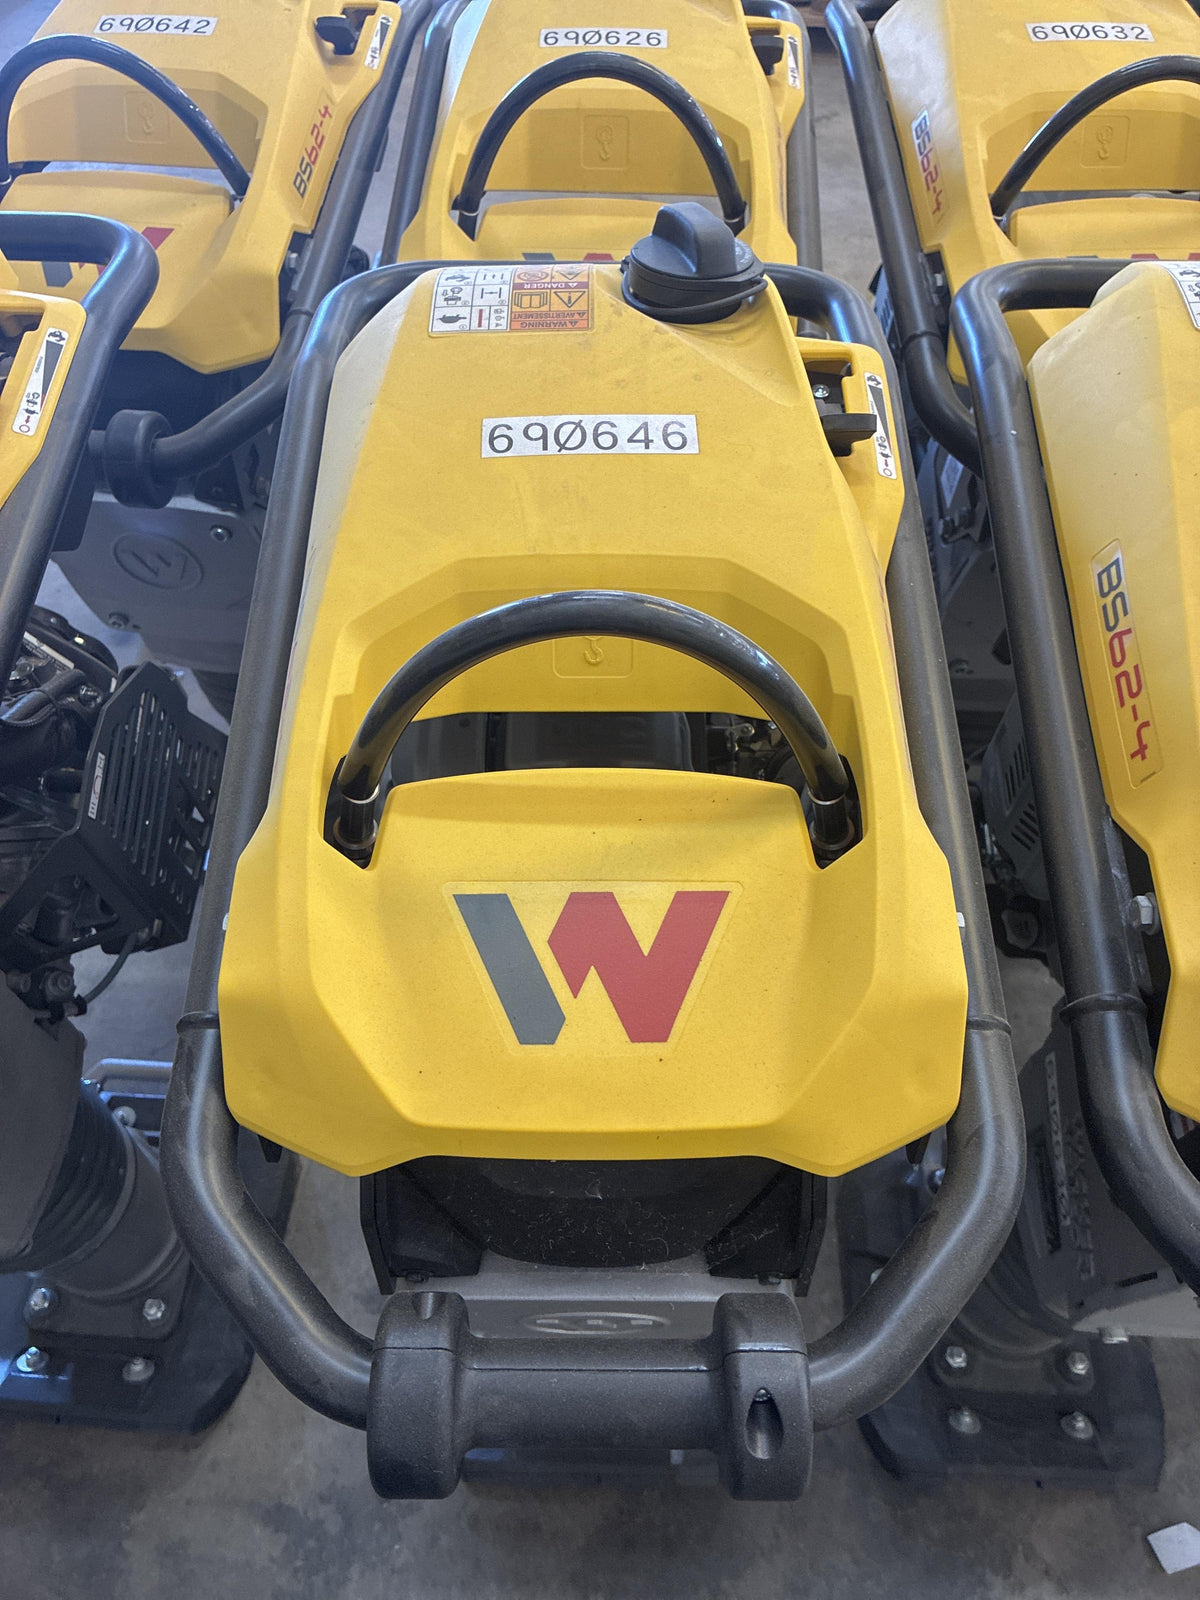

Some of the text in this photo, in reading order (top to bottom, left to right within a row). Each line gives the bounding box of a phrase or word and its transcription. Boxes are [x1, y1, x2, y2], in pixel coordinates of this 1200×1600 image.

[292, 104, 333, 199] BS62-4
[513, 311, 575, 320] AVERTISSEMENT
[520, 320, 568, 329] WARNING
[1096, 556, 1151, 762] BS62-4
